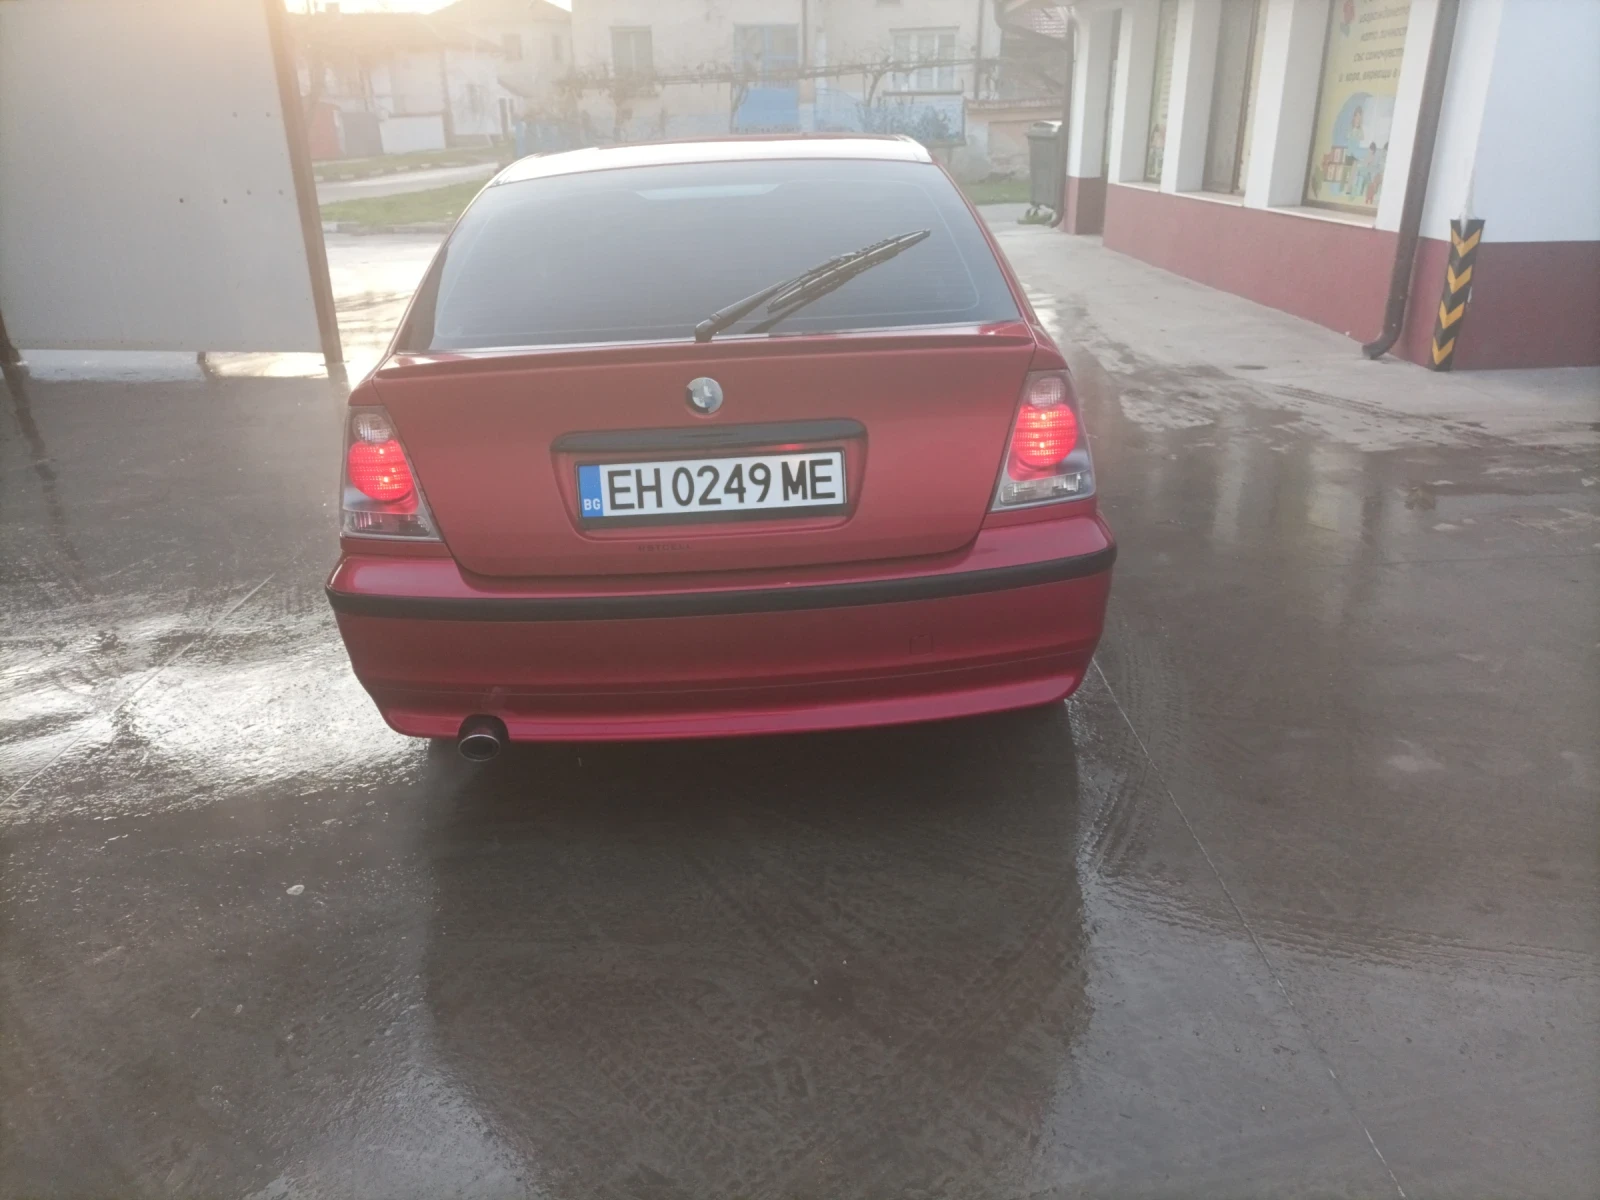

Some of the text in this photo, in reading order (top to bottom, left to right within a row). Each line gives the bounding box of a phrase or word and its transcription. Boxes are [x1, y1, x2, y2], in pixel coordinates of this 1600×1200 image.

[607, 458, 837, 511] EH 0249 ME
[583, 498, 601, 511] BG
